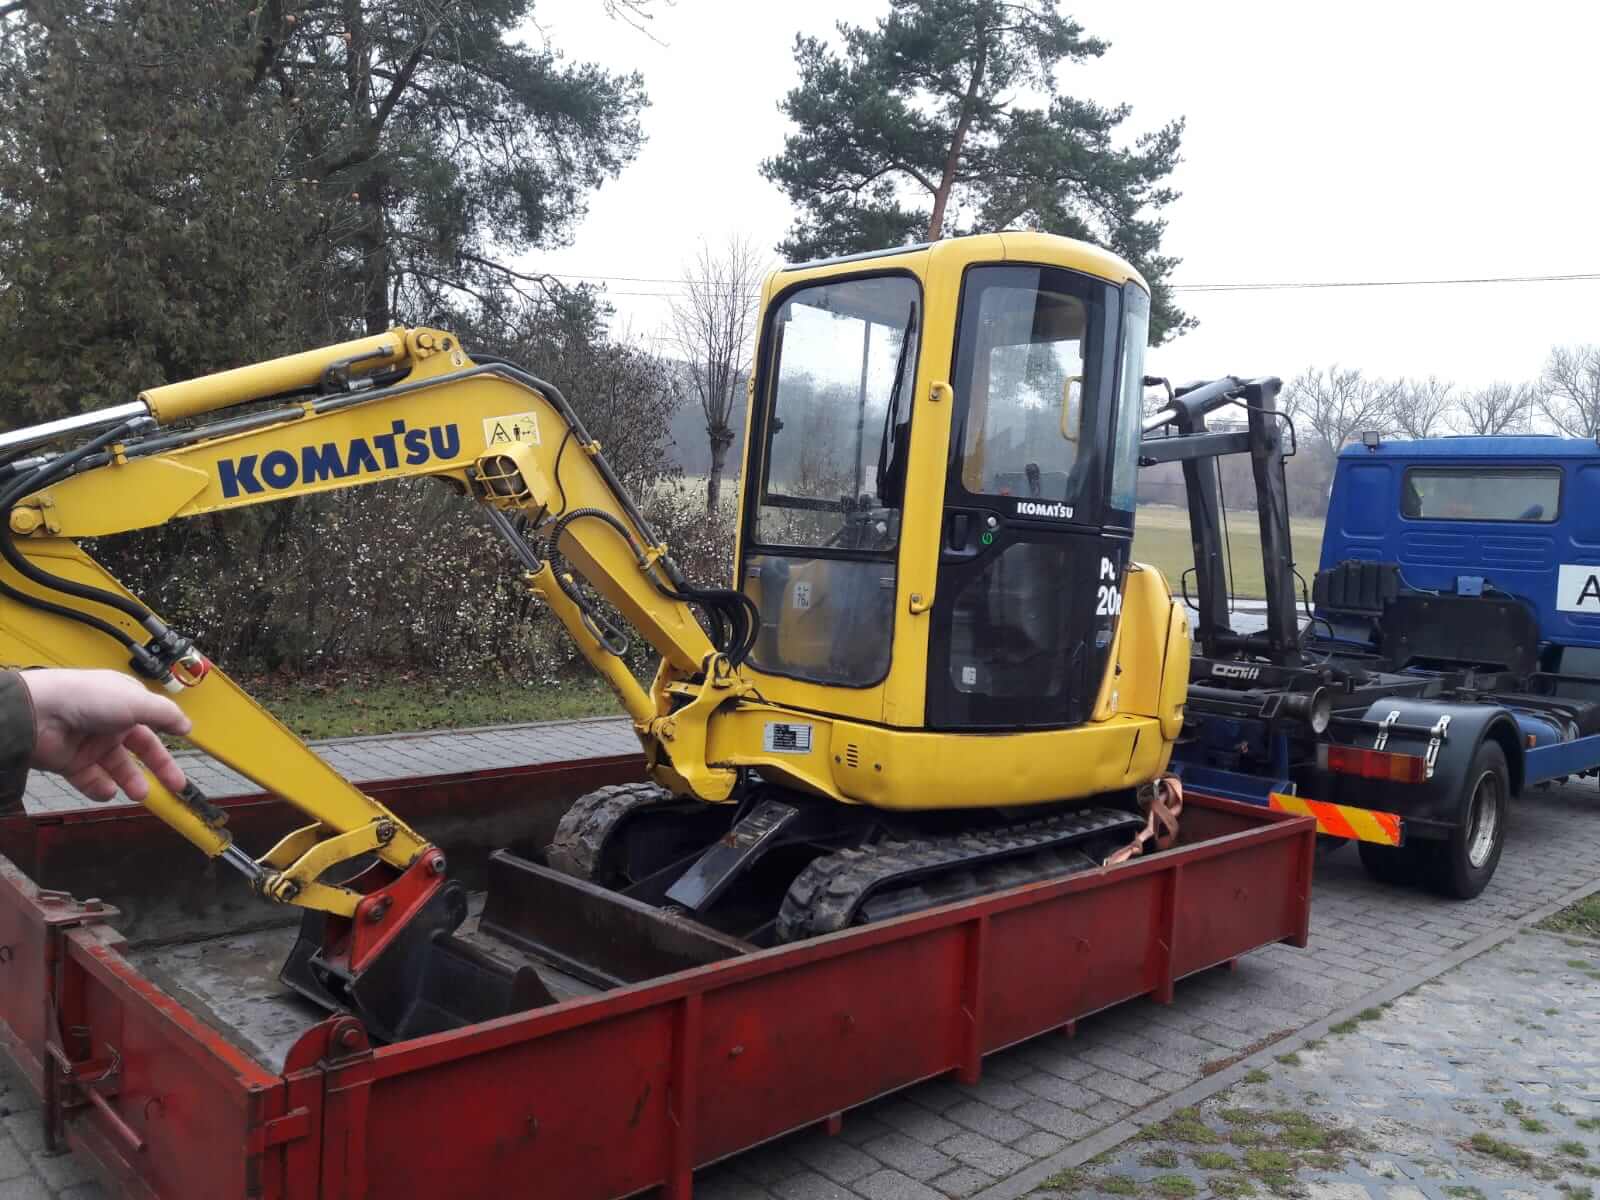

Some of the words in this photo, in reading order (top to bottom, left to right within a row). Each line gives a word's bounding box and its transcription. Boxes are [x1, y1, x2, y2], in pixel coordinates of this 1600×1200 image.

[217, 420, 460, 498] KOMATSU
[1017, 502, 1074, 518] KOMATSU
[1576, 574, 1600, 605] A
